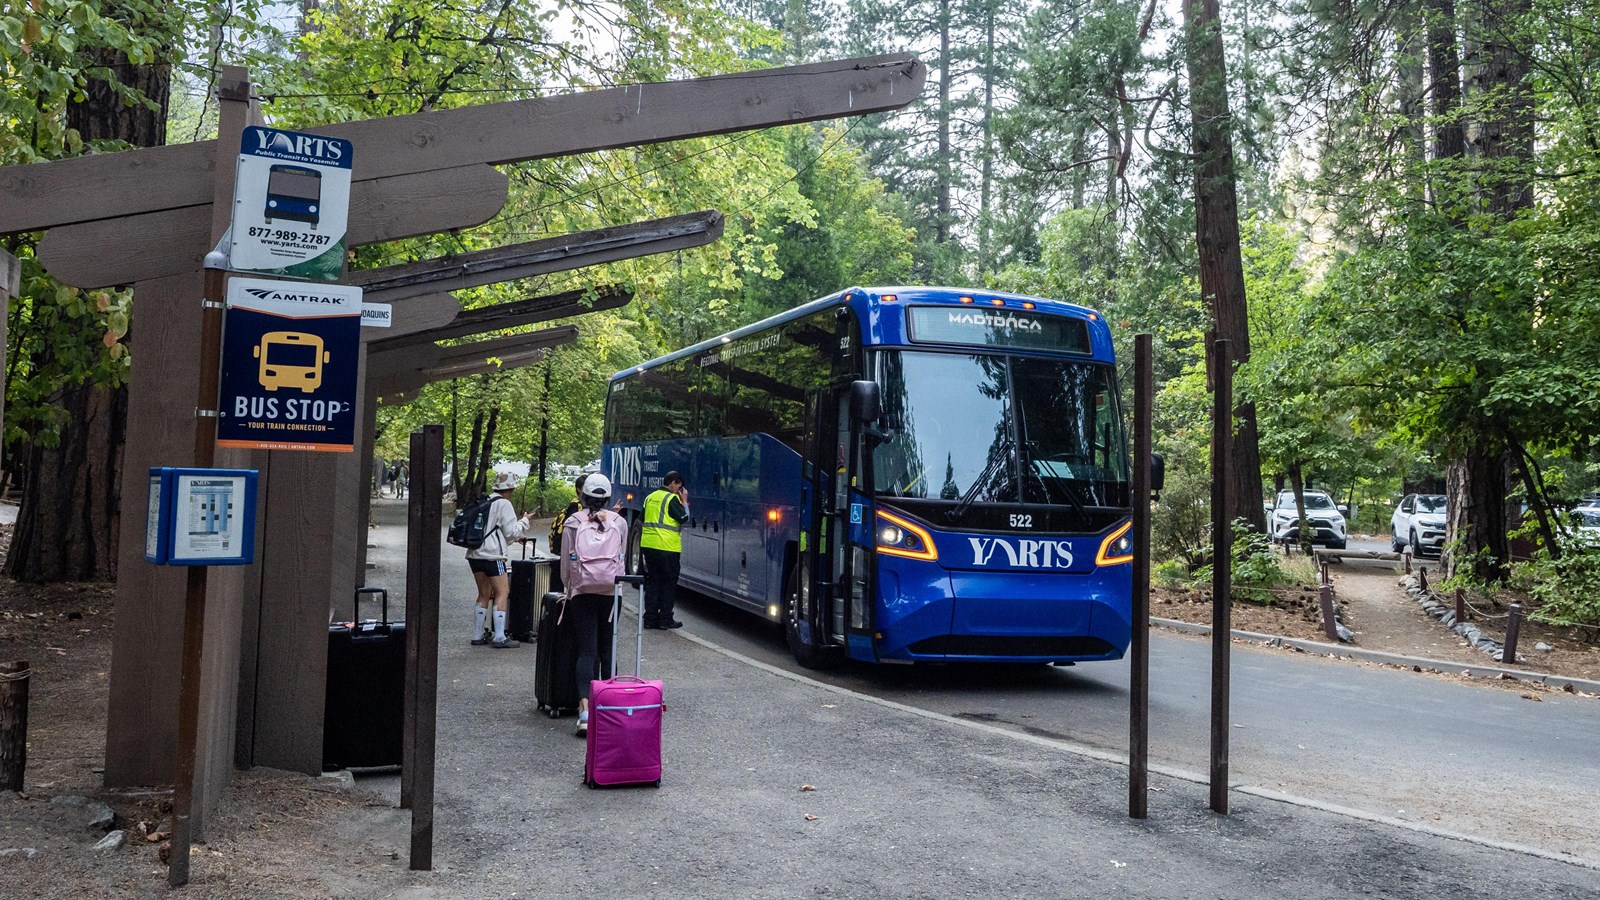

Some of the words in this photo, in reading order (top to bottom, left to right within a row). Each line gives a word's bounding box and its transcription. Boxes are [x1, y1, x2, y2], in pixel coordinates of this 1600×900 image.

[256, 129, 342, 160] YARTS
[255, 149, 276, 158] Public
[277, 152, 301, 161] Transit
[309, 157, 340, 166] Yosemite
[248, 226, 331, 246] 877-989-2787
[261, 238, 318, 251] www.yarts.com
[272, 293, 342, 305] AMTRAK
[720, 341, 759, 361] TRANSPORTATION
[760, 333, 780, 350] SYSTEM
[234, 395, 279, 420] BUS
[285, 398, 341, 421] STOP
[248, 421, 265, 429] YOUR
[266, 422, 285, 430] TRAIN
[286, 423, 326, 432] CONNECTION
[610, 445, 642, 487] YARTS
[1009, 513, 1033, 528] 522
[967, 537, 1074, 569] YARTS
